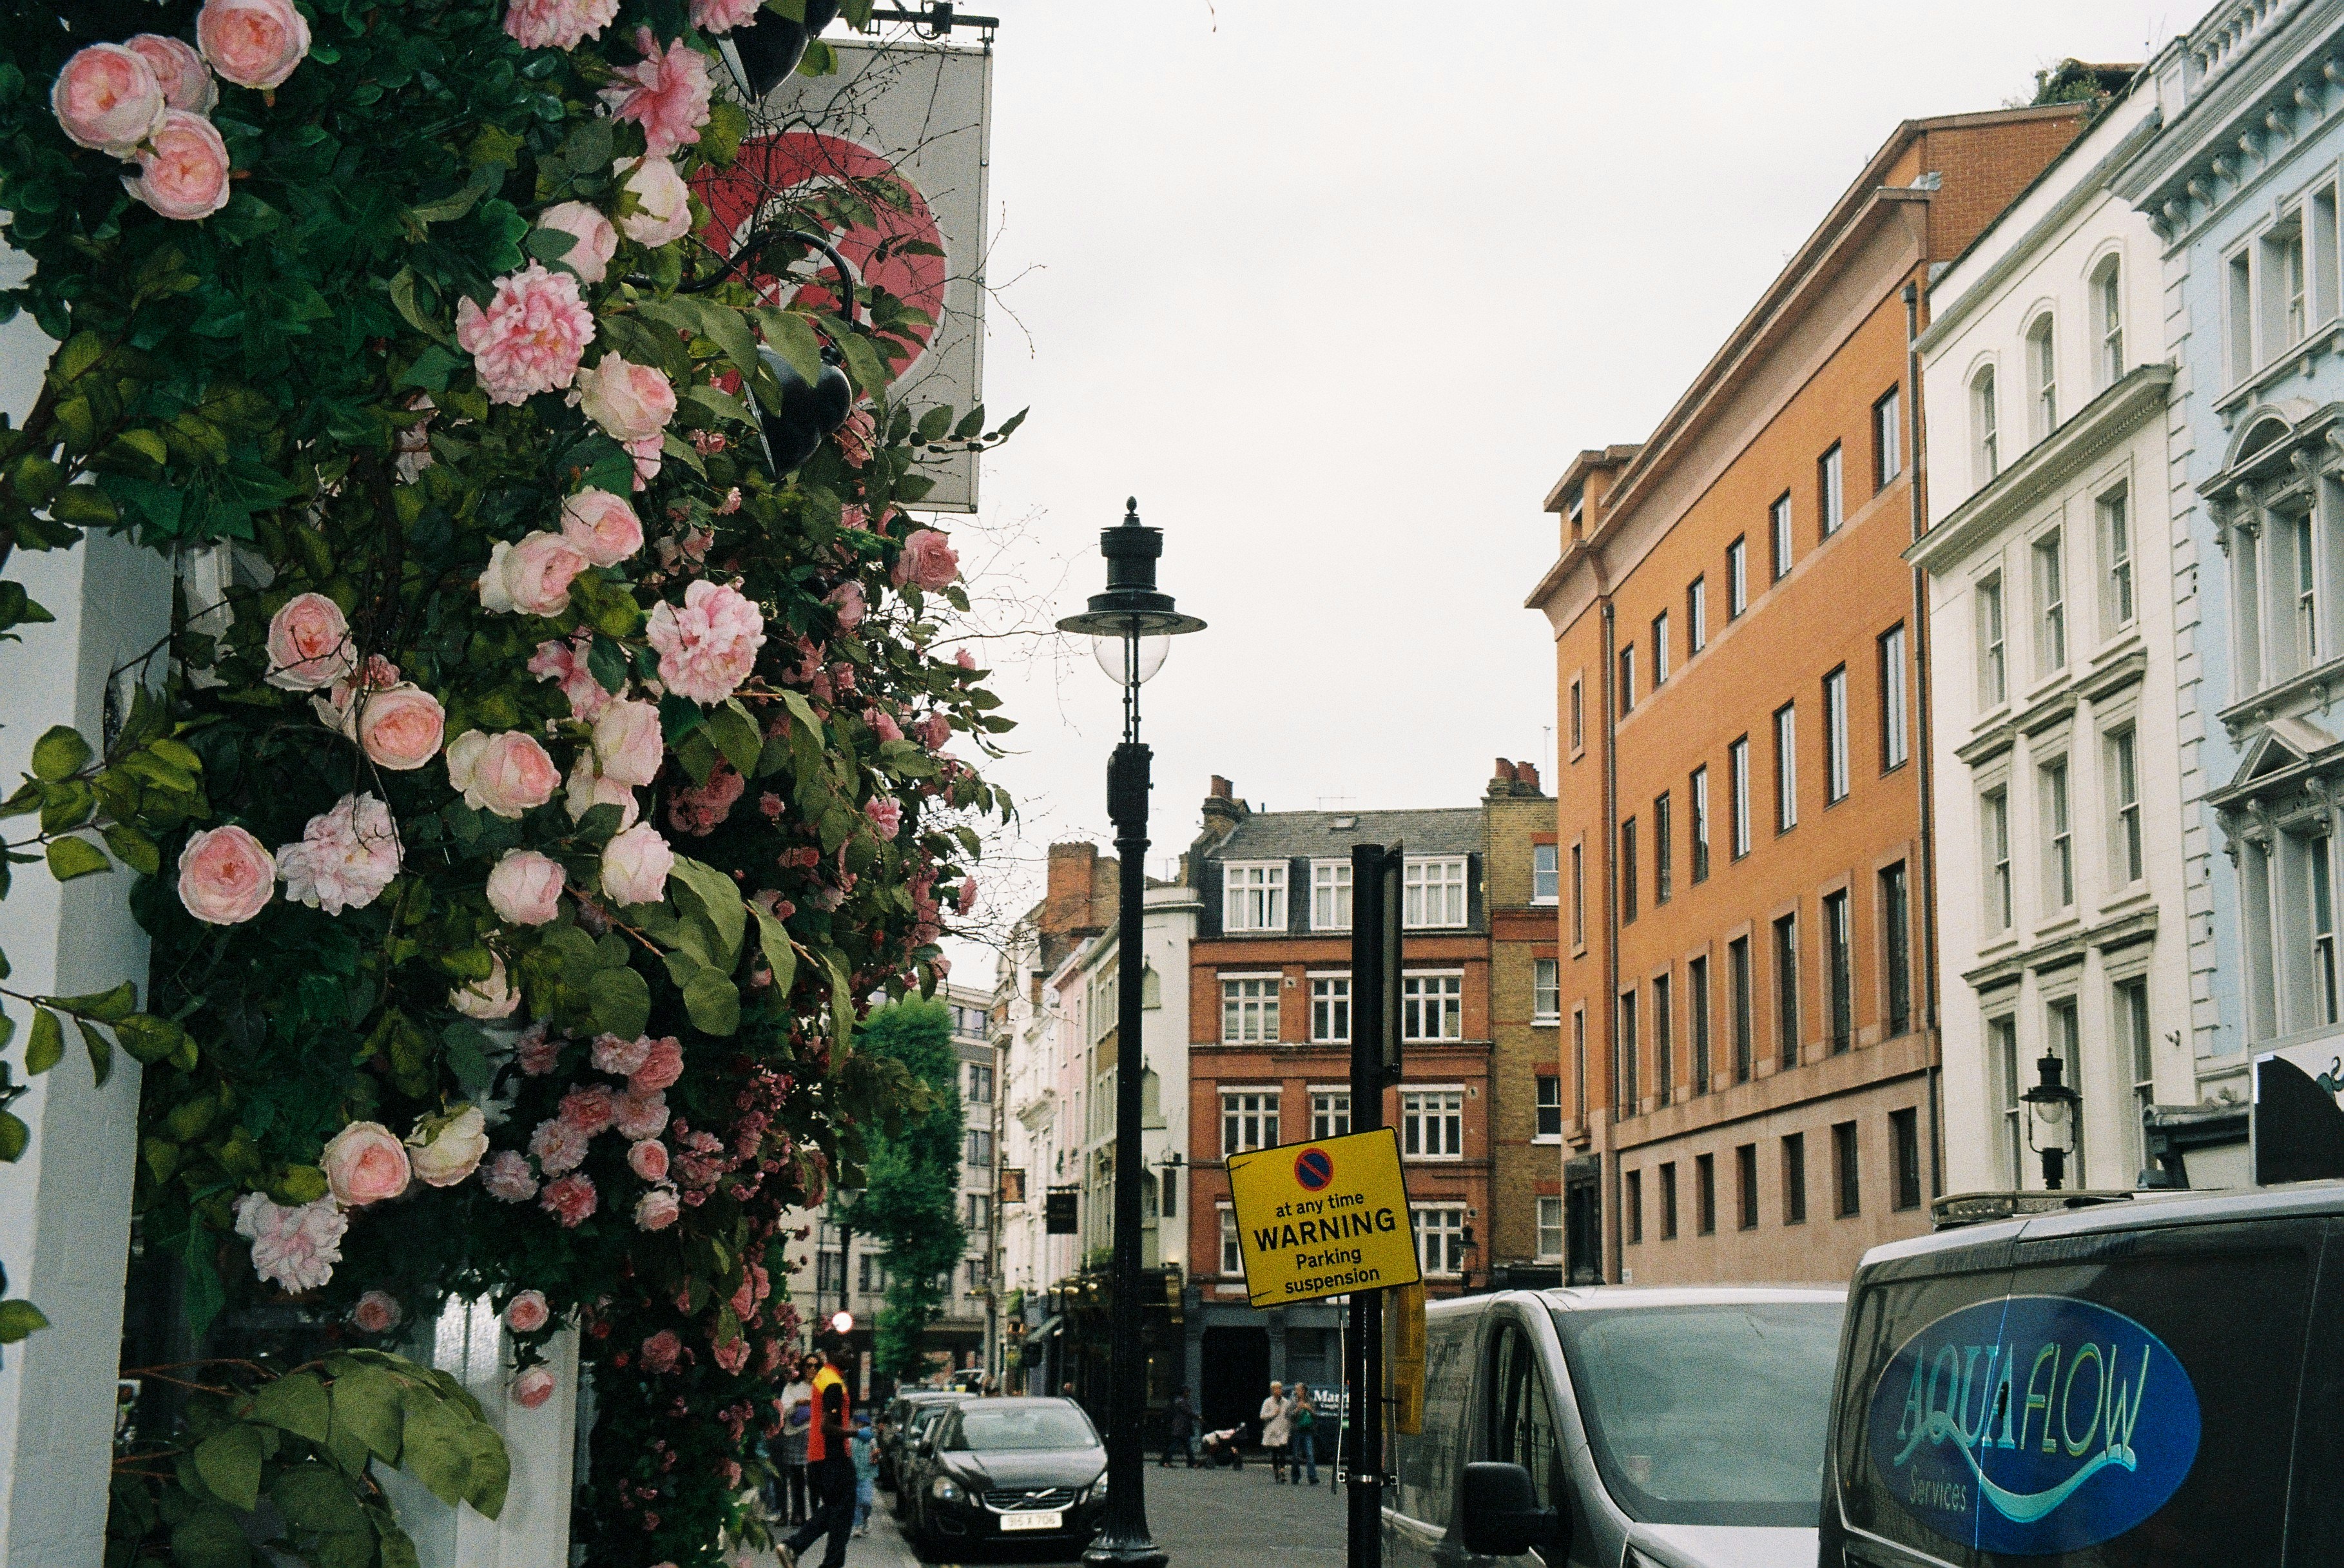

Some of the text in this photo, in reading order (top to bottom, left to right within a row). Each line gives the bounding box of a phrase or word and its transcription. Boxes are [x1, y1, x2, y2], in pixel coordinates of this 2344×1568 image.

[1275, 1193, 1364, 1218] at any time
[1253, 1207, 1397, 1252] WARNING
[1295, 1248, 1362, 1270] Parking
[1284, 1267, 1380, 1294] suspension
[1910, 1464, 1968, 1513] Services
